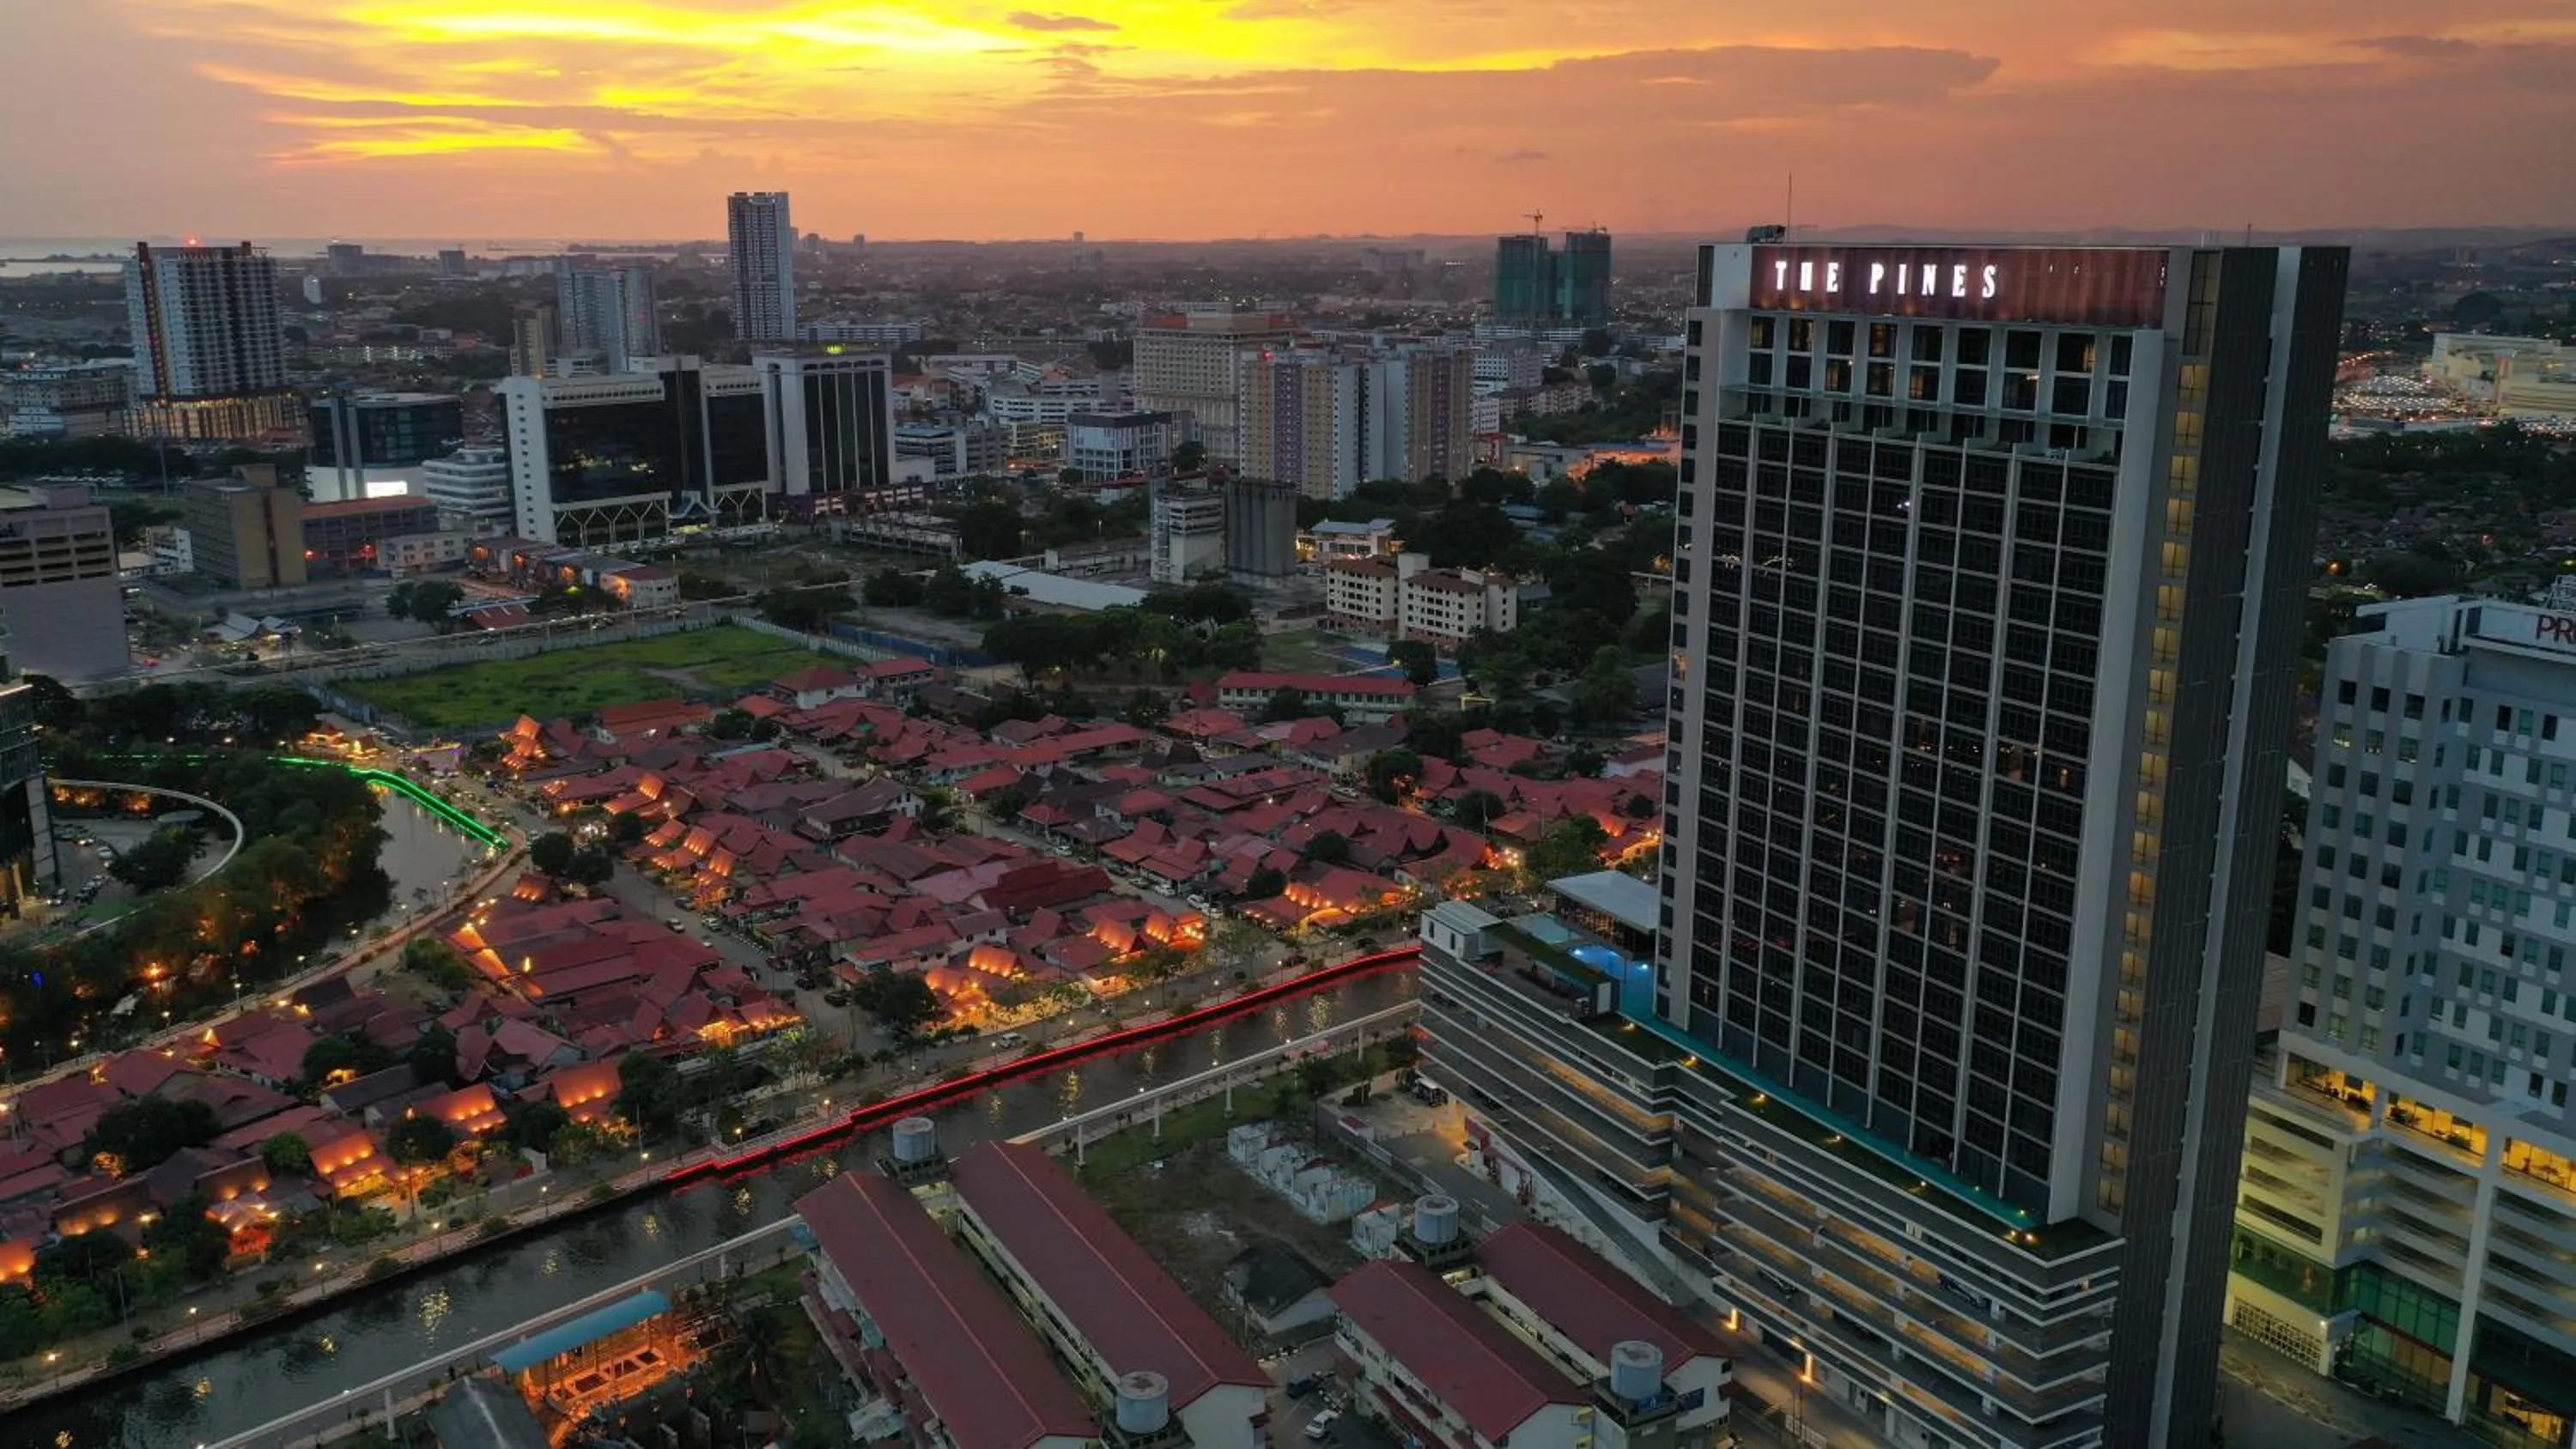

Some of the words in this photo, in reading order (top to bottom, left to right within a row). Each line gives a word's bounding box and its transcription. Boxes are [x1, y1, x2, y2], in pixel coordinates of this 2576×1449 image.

[1776, 261, 1839, 293] THE
[1869, 262, 1997, 298] PINES
[2535, 614, 2576, 645] PR
